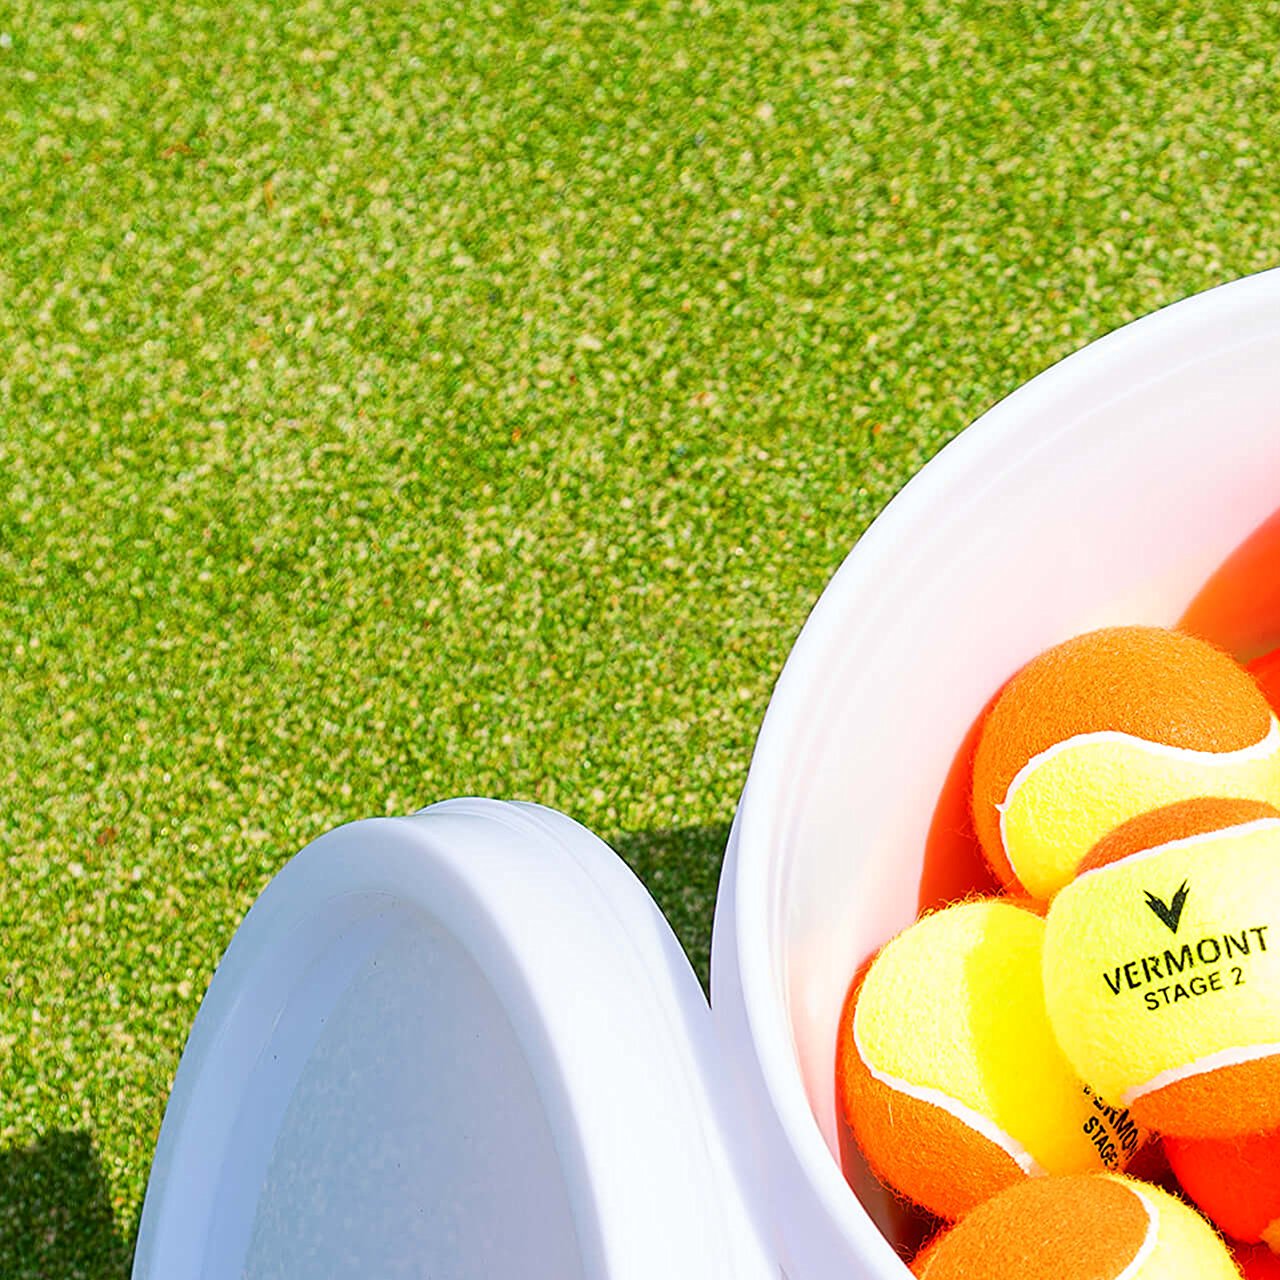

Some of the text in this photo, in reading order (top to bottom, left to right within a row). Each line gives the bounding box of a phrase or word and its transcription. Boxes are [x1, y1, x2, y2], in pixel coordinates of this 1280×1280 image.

[1103, 926, 1268, 995] VERMONT
[1144, 967, 1246, 1011] STAGE 2
